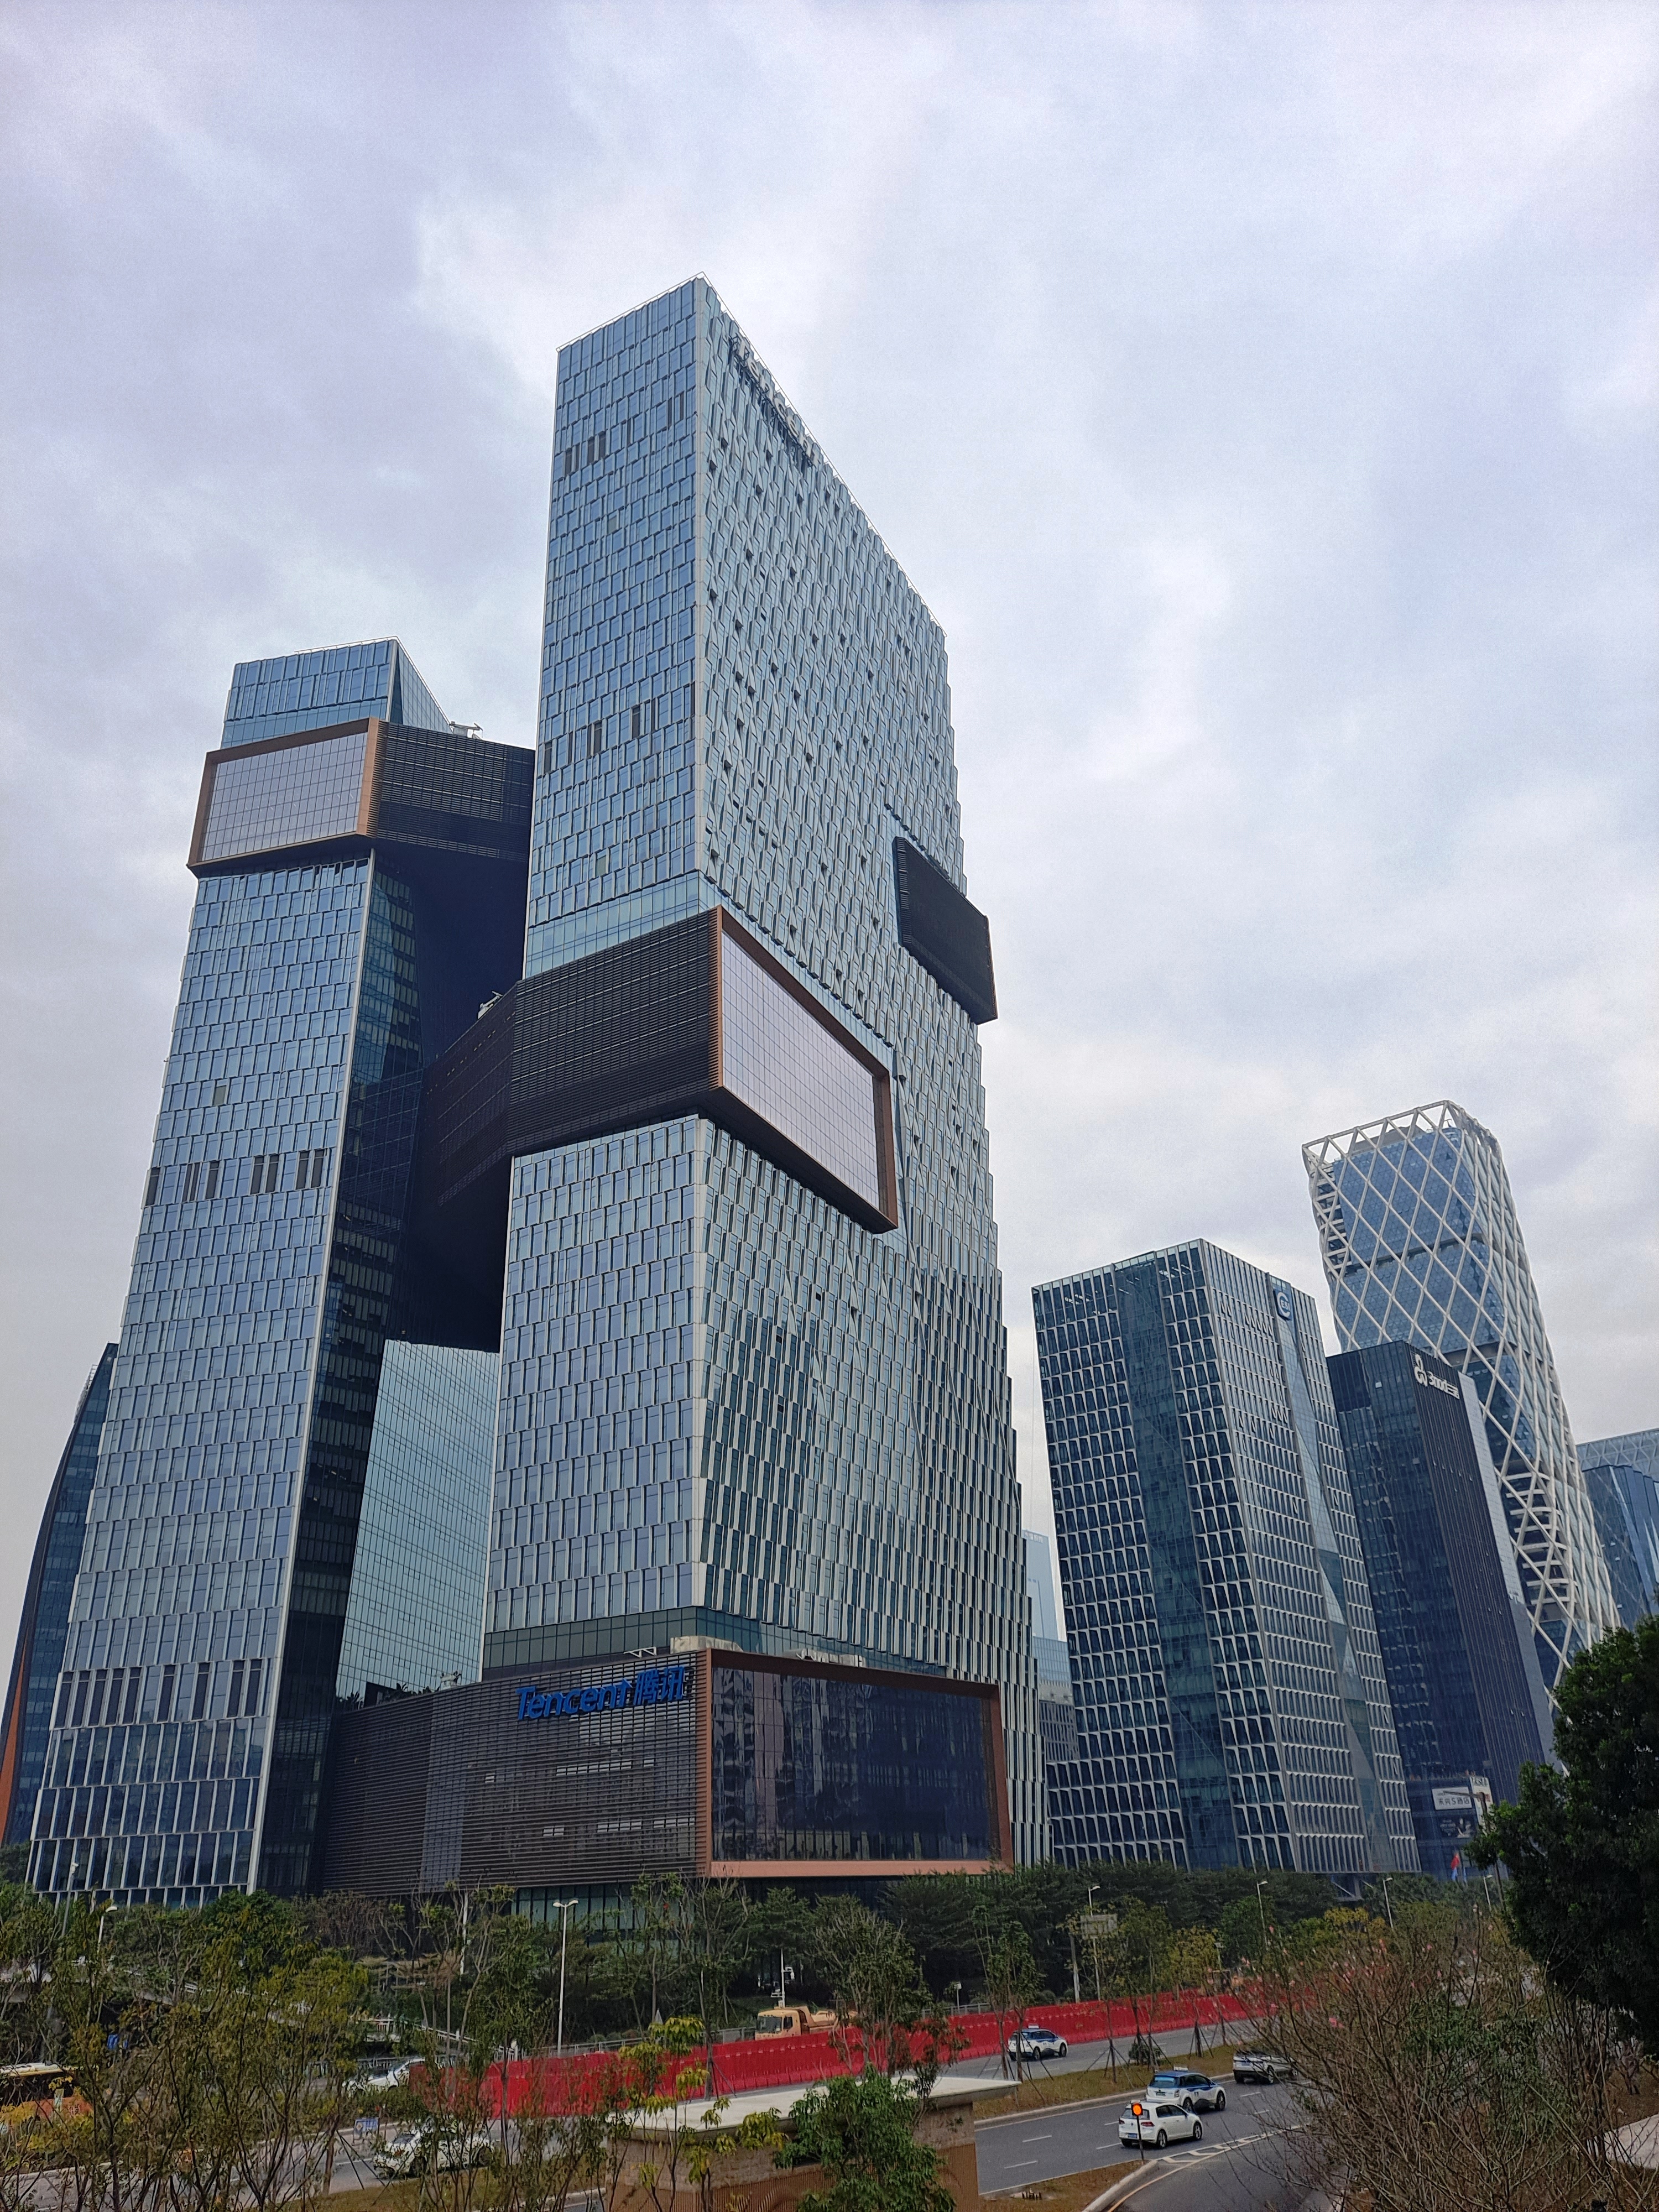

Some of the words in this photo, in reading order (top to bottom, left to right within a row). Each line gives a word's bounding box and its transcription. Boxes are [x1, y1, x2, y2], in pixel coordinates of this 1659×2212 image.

[735, 332, 821, 468] Tencent
[1277, 1292, 1291, 1317] CESI
[515, 1678, 633, 1720] Tencent
[633, 1666, 686, 1706] 腾讯
